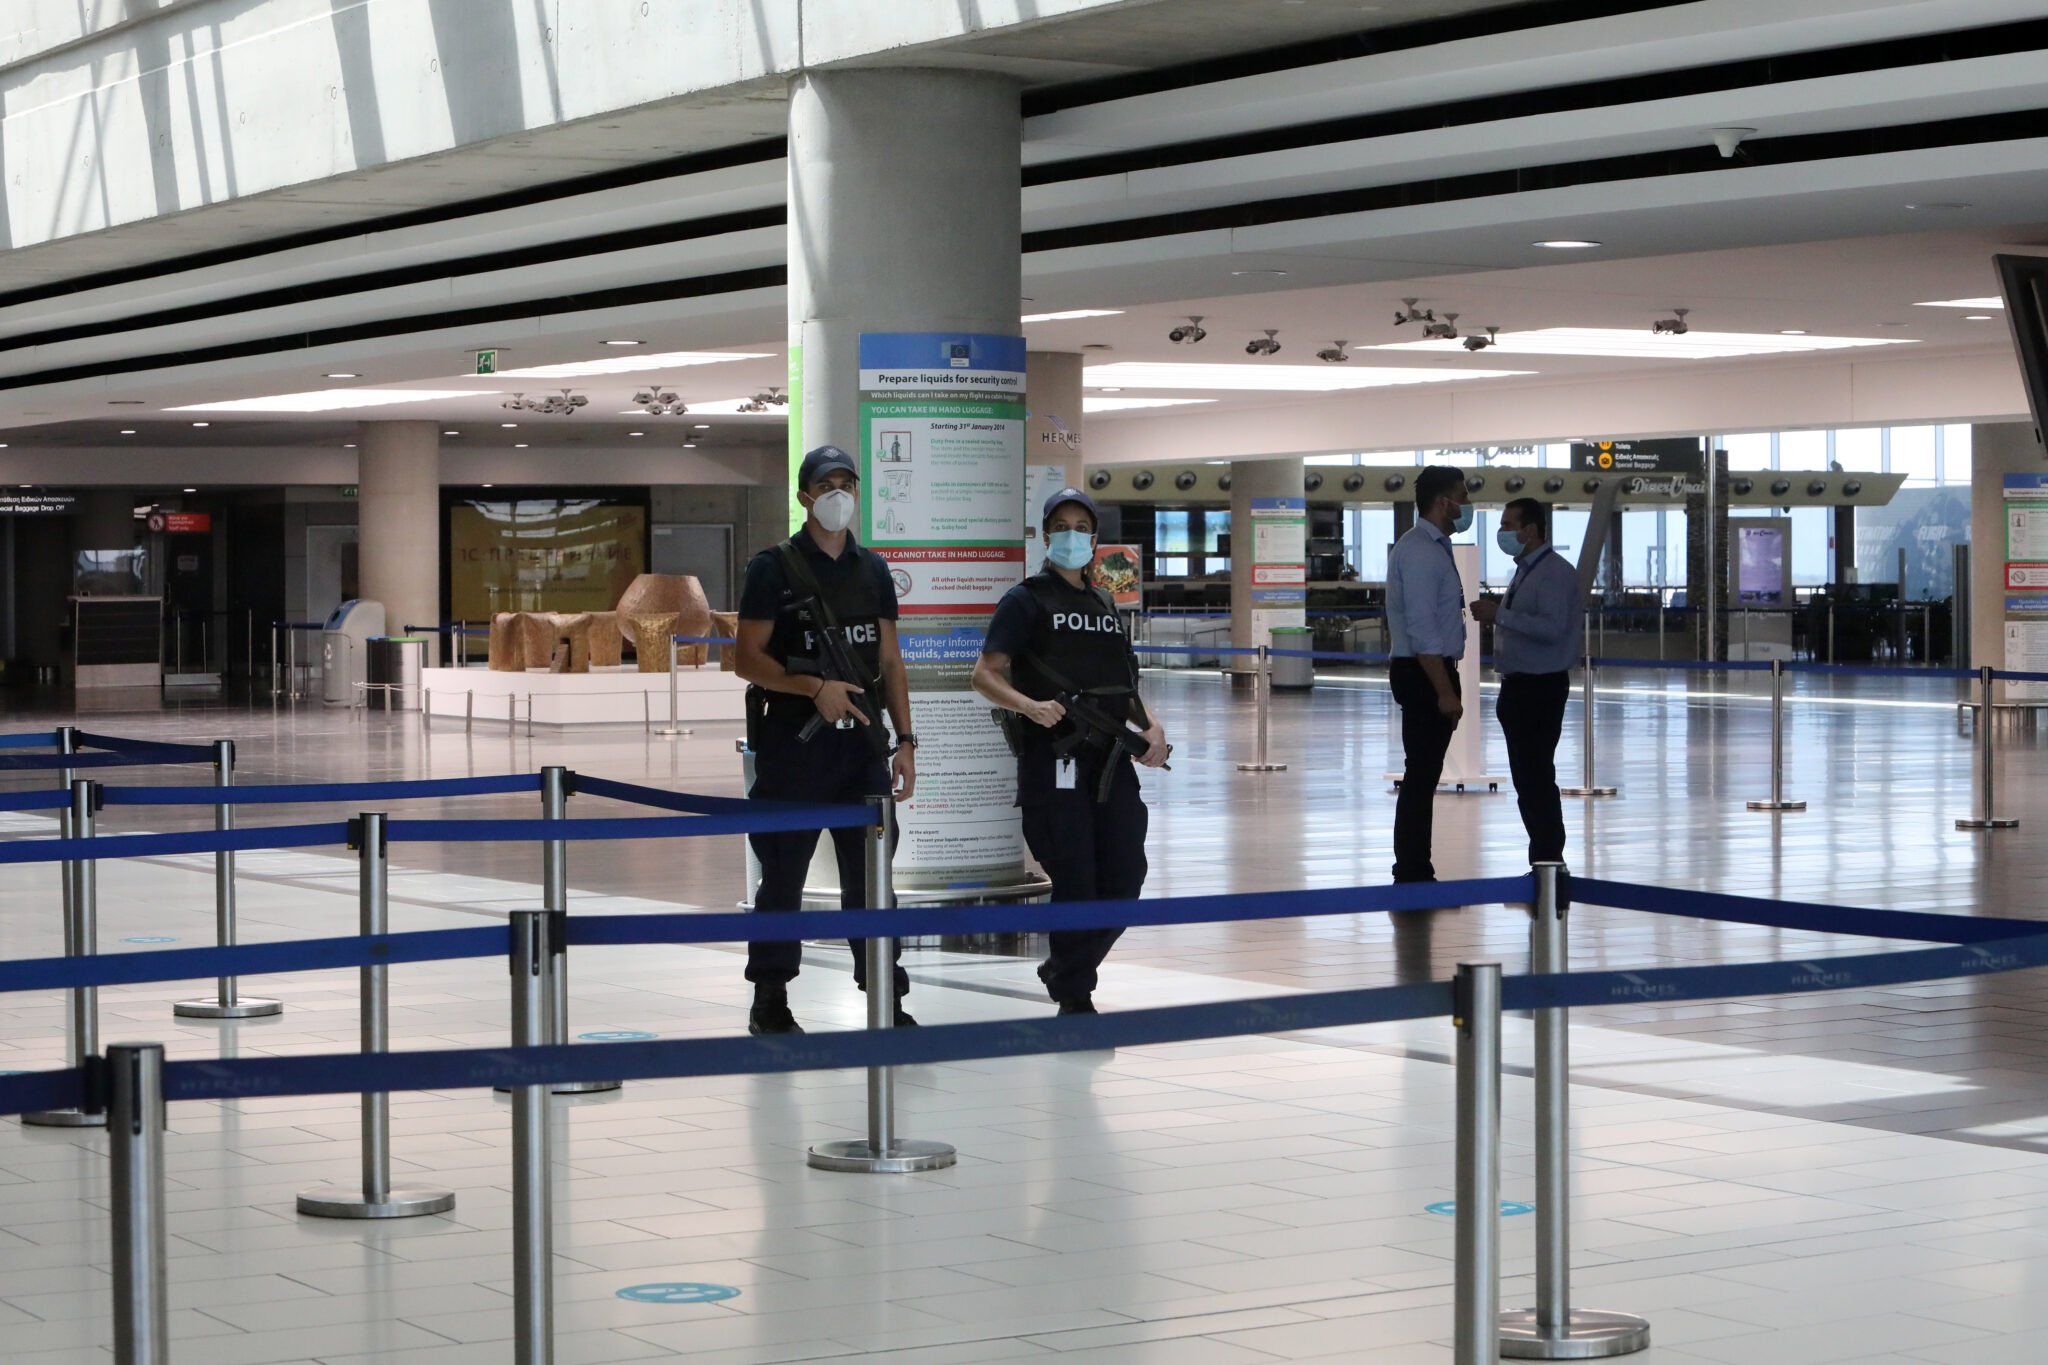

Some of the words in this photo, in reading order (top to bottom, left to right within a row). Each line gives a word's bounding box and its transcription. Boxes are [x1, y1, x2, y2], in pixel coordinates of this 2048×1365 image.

[878, 374, 918, 385] Prepare
[920, 375, 953, 385] liquids
[956, 375, 968, 385] for
[970, 376, 1000, 386] security
[1001, 376, 1018, 386] control
[930, 423, 958, 431] Starting
[1053, 612, 1122, 634] POLICE
[804, 624, 877, 650] PICE
[909, 638, 946, 647] Further
[901, 649, 940, 660] liquids,
[1791, 972, 1852, 986] HERMES
[1611, 983, 1676, 997] HERMES
